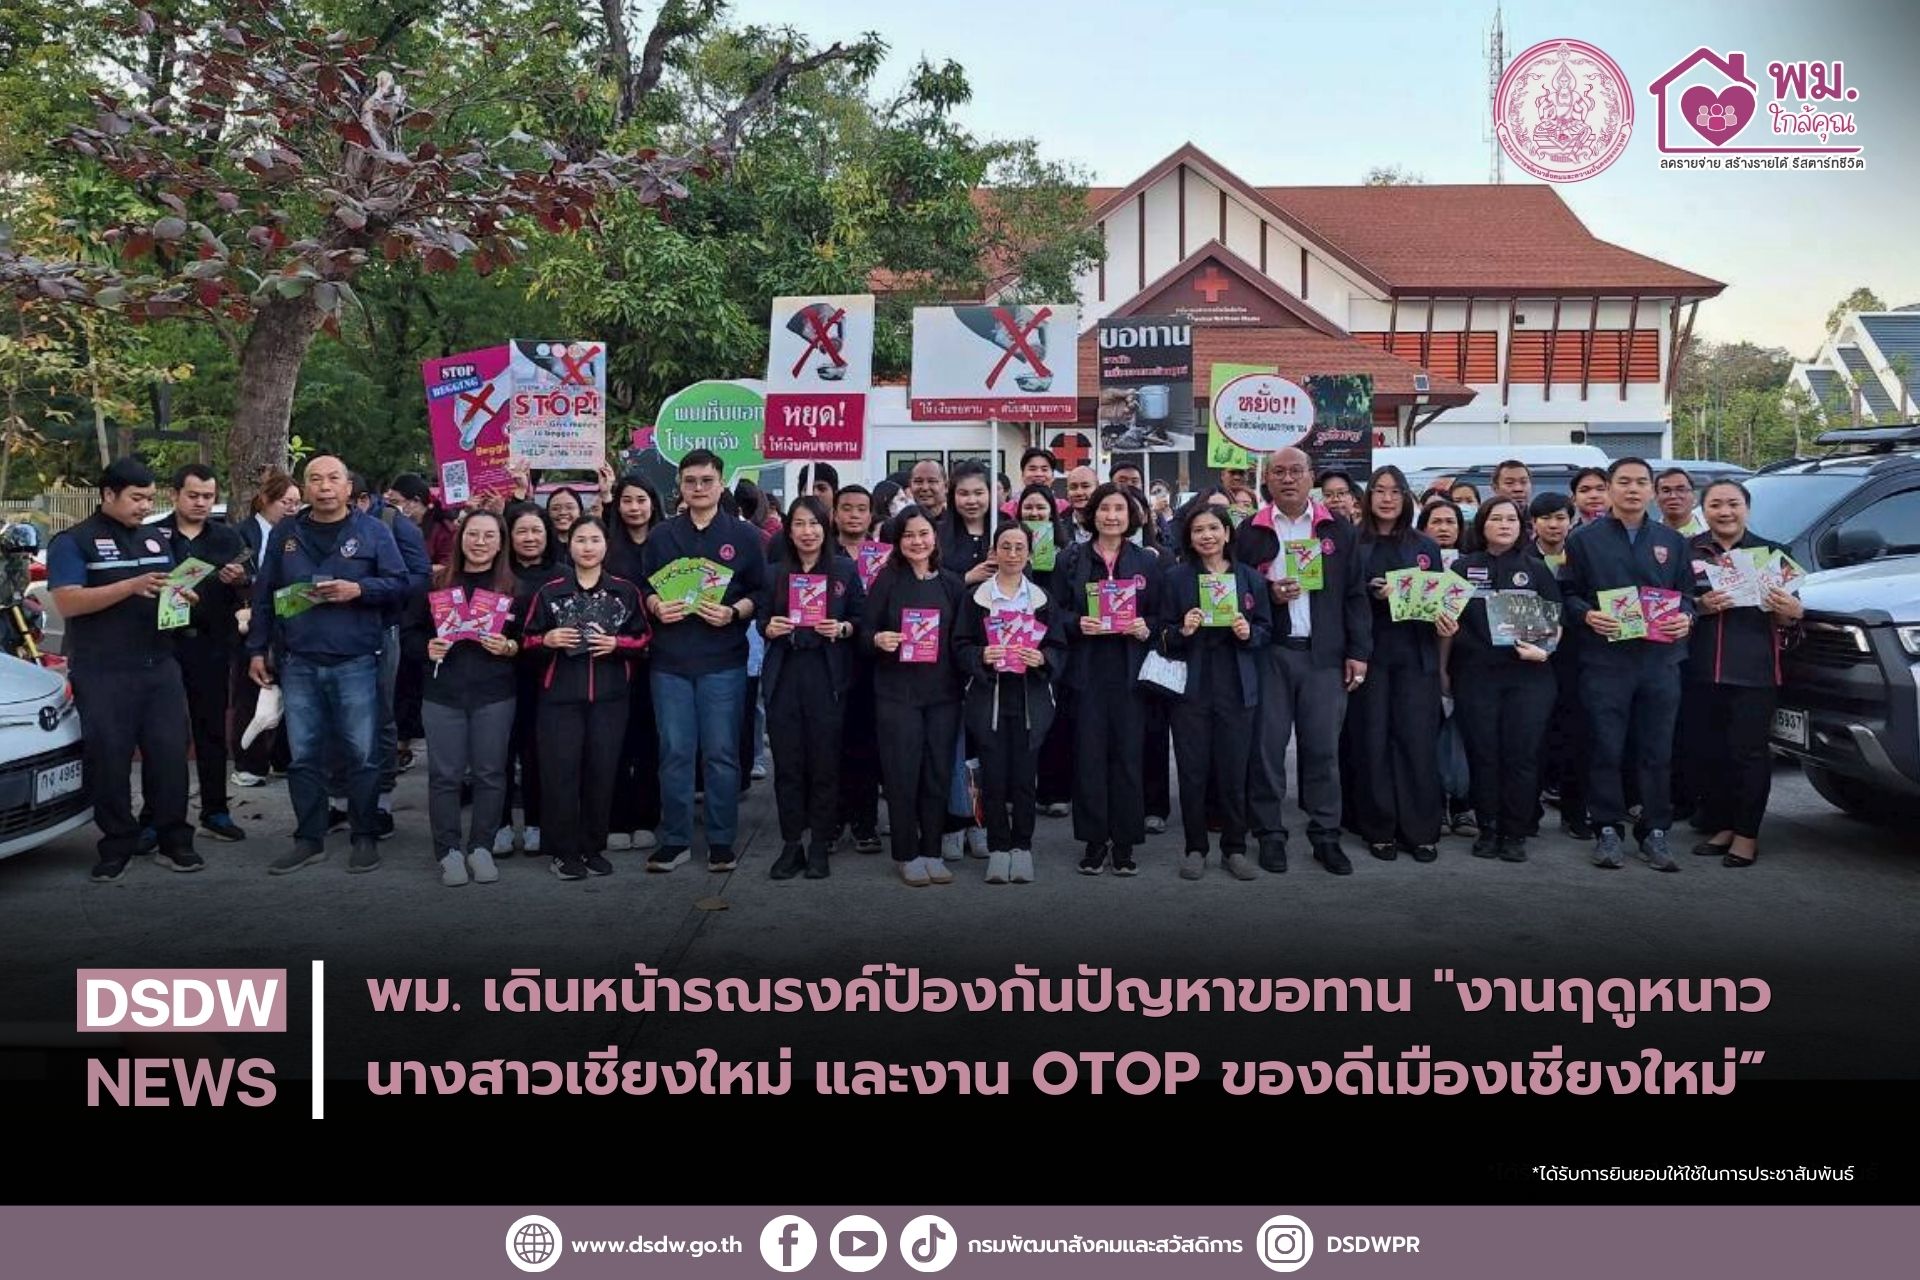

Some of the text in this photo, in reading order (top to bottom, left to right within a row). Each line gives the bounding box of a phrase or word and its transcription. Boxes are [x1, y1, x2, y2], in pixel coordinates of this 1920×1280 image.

[1100, 325, 1191, 349] ขอทาน
[441, 365, 475, 380] STOP
[515, 393, 598, 417] STOP!
[783, 401, 846, 438] หยุด!
[665, 429, 739, 451] โปรดแจ้ง
[768, 436, 858, 453] ให้เงินคนขอทาน
